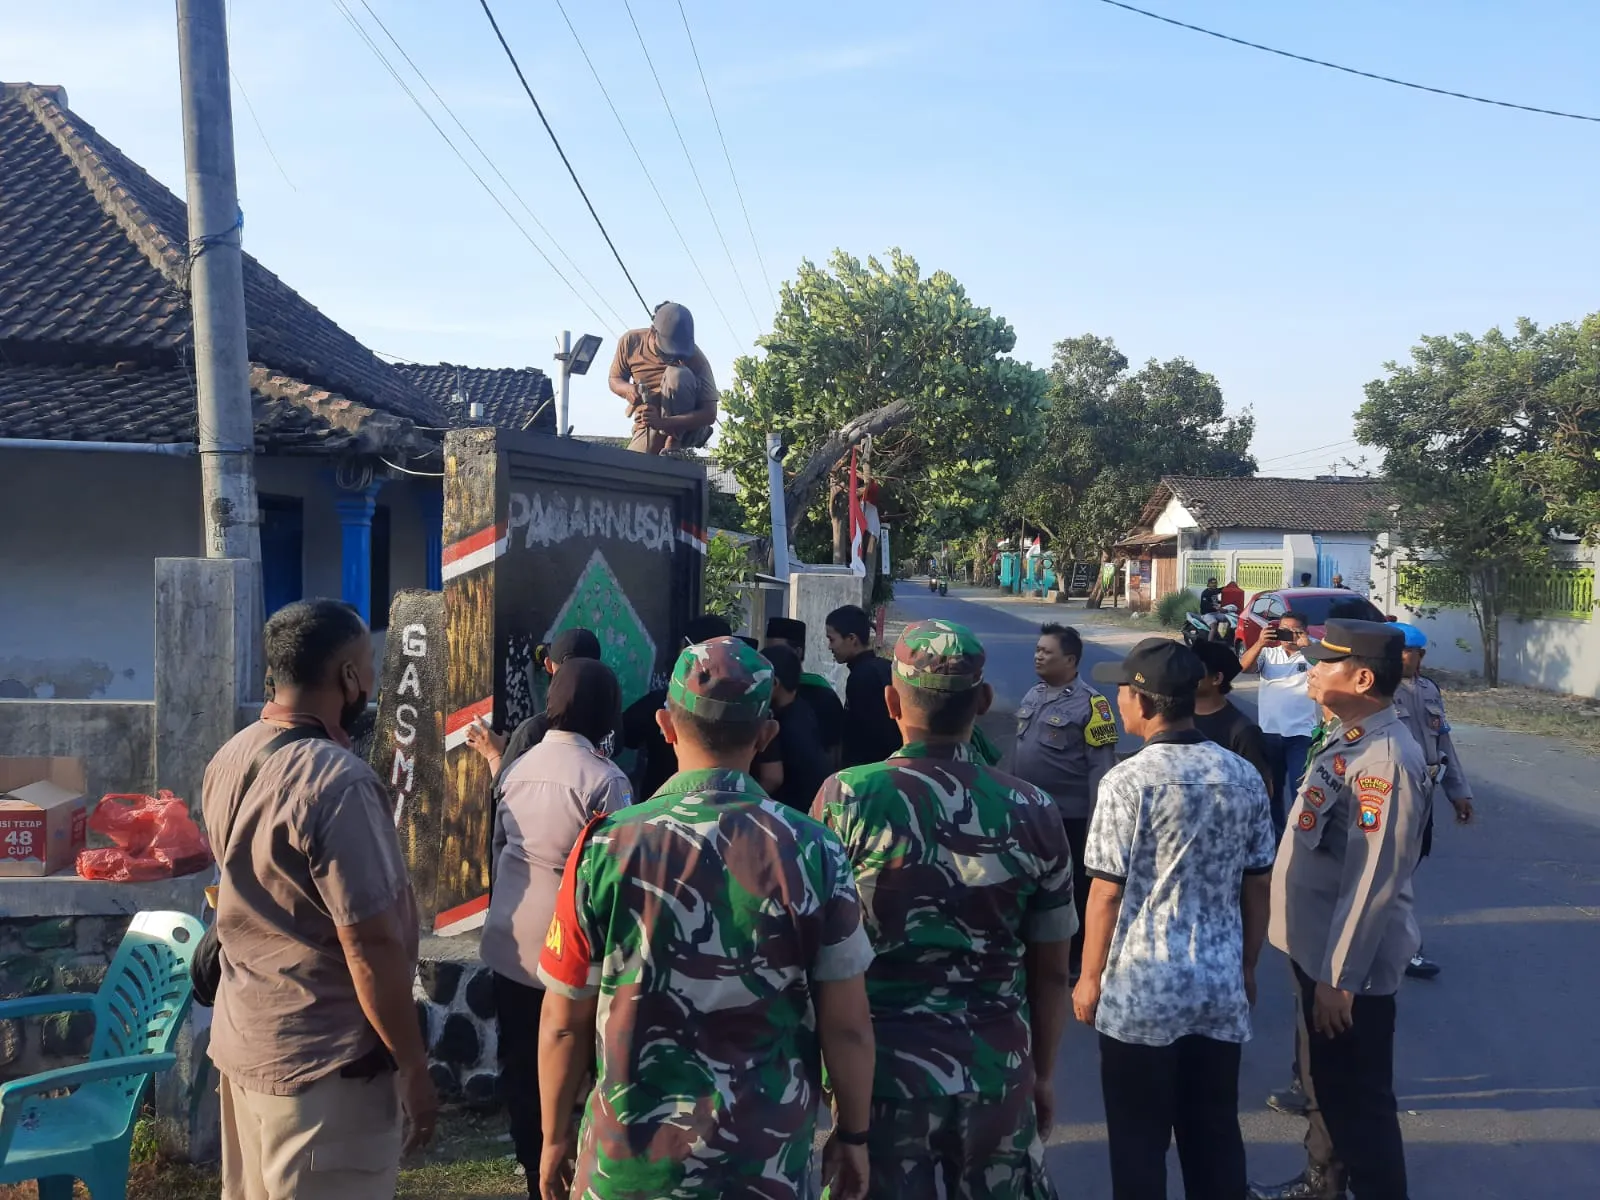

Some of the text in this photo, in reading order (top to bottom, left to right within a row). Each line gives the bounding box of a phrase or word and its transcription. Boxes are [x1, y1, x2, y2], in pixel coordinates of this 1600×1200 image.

[392, 623, 427, 828] GASMI
[1316, 765, 1342, 793] POLRI
[15, 820, 43, 828] TETAP
[4, 830, 33, 845] 48
[8, 846, 33, 855] CUP
